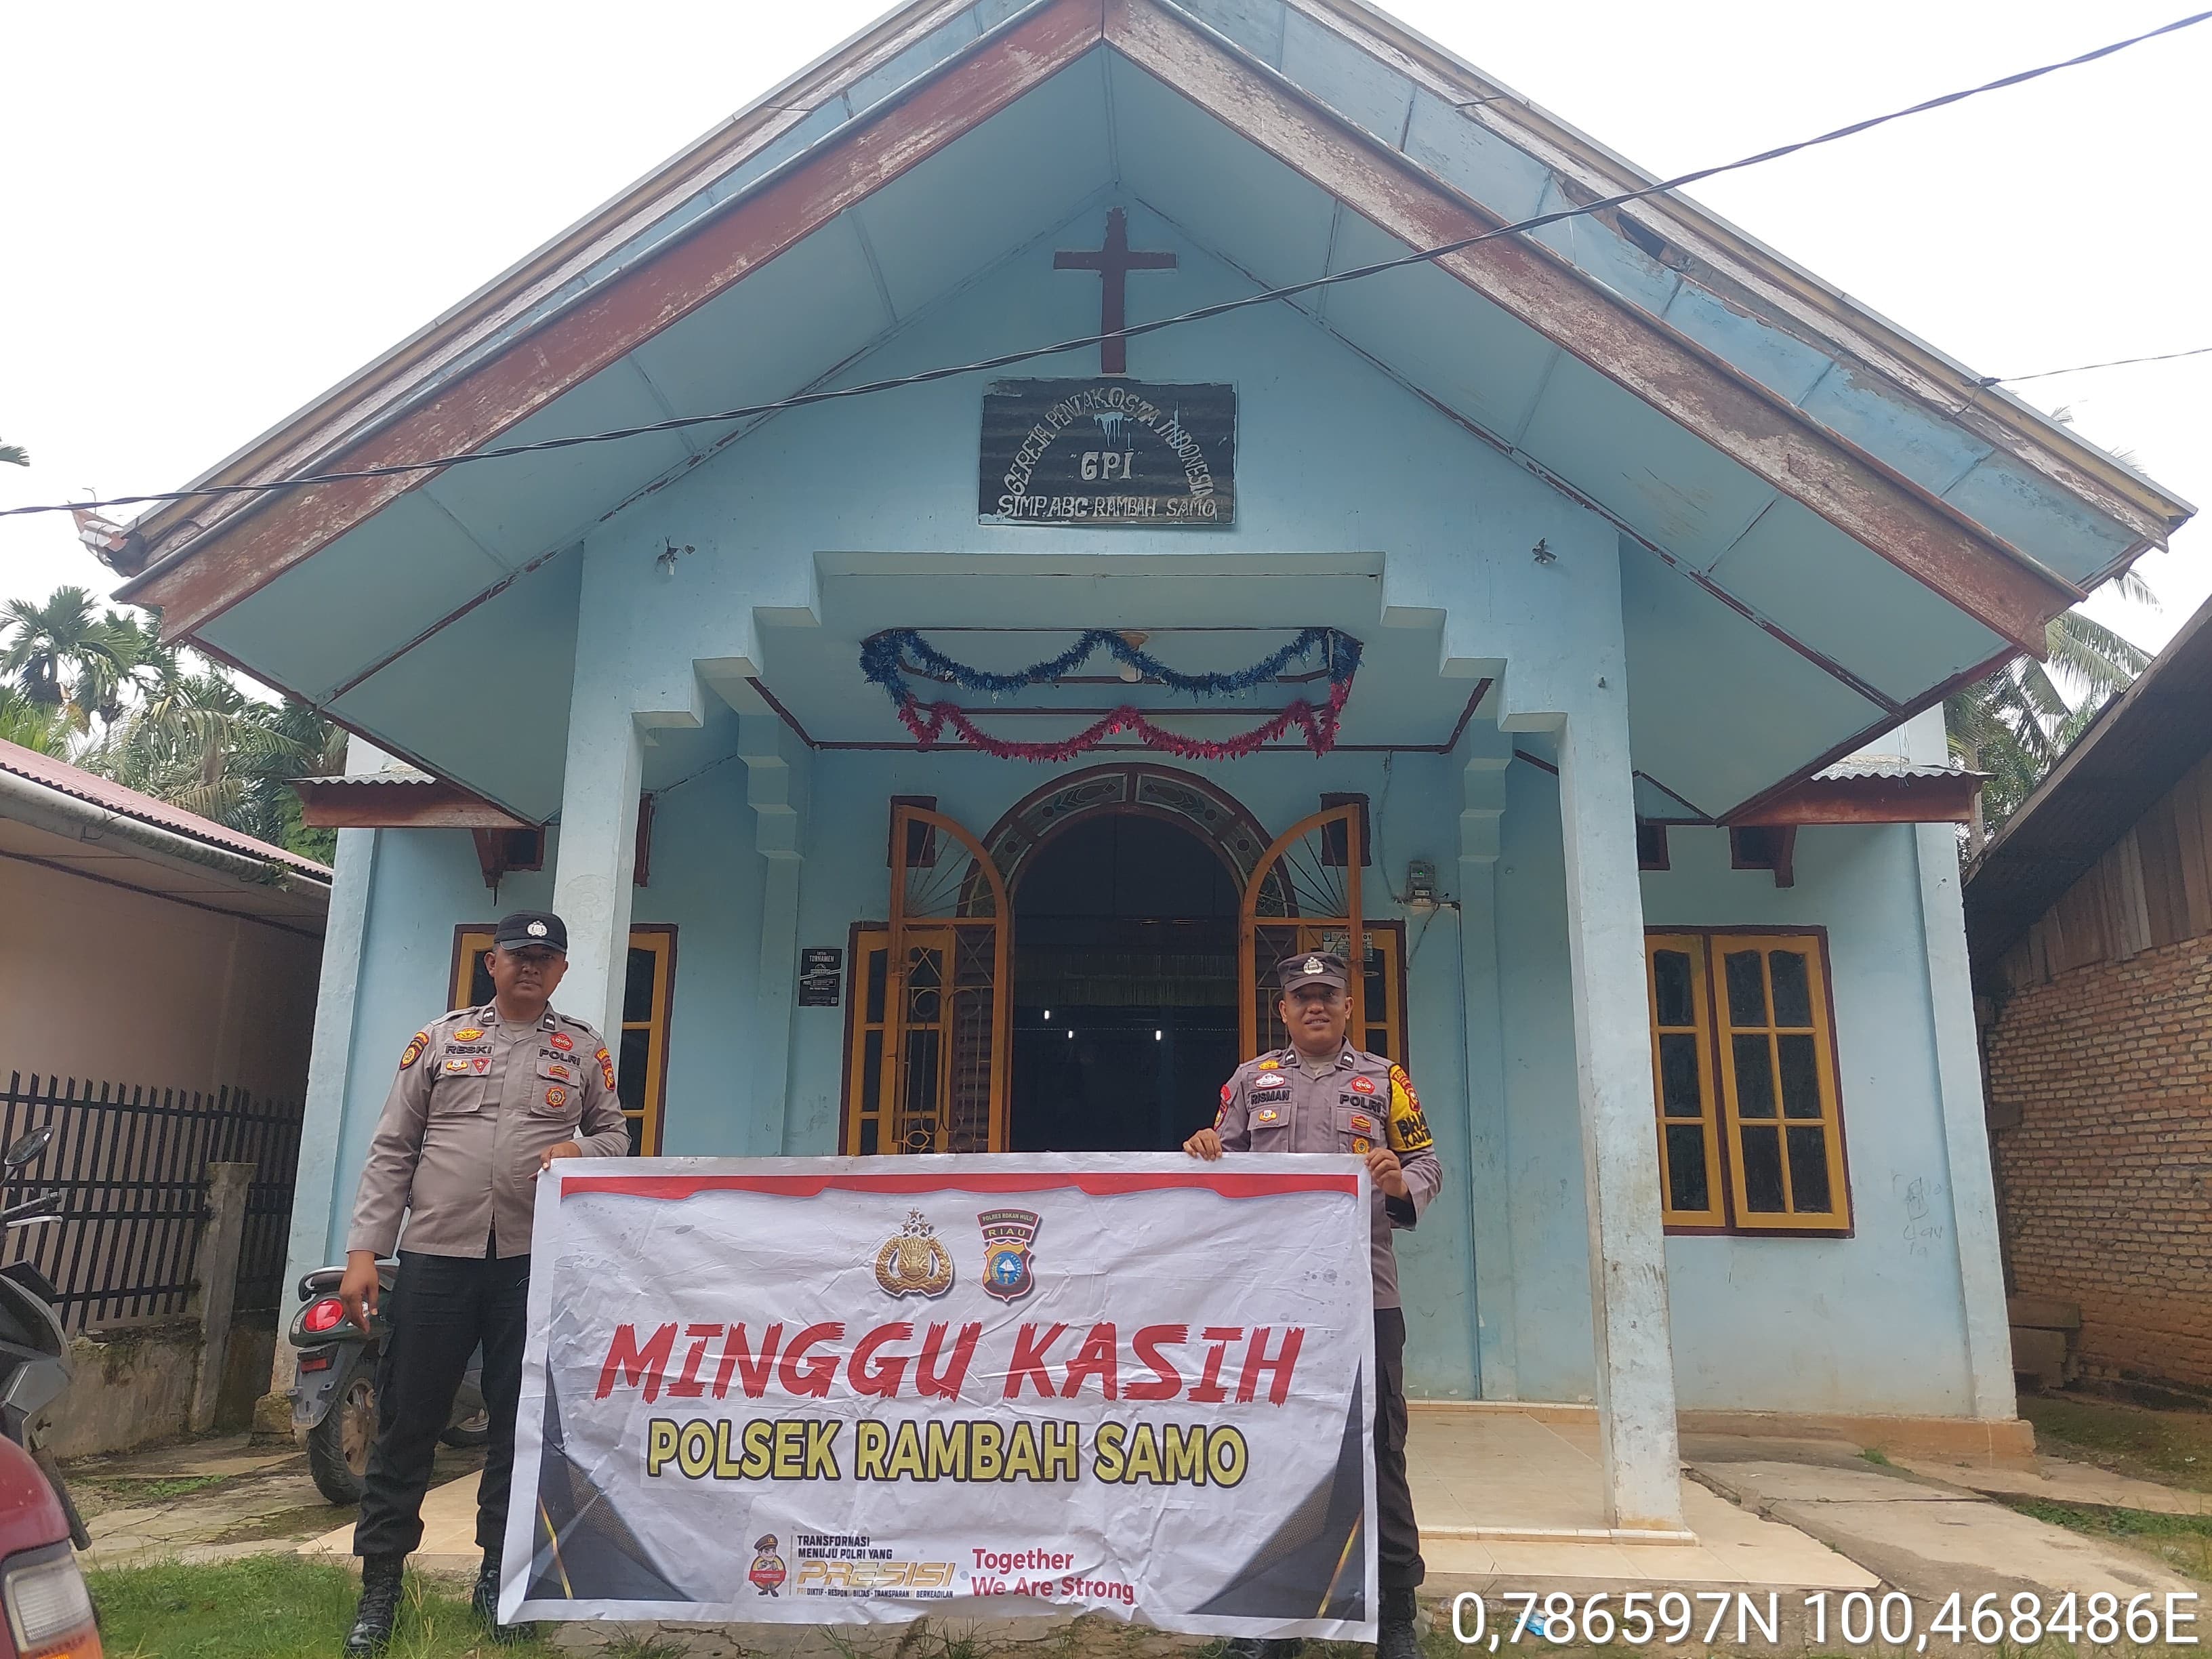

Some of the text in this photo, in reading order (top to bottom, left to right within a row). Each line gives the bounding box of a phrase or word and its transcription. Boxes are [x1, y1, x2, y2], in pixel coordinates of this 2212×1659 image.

[1004, 423, 1056, 495] GEREJA
[1044, 387, 1161, 430] PENTAKOSTA
[1166, 498, 1216, 518] SAMO
[445, 1045, 493, 1054] RESKI
[539, 1048, 581, 1066] POLRI
[1250, 1090, 1290, 1105] RISMAN
[1339, 1094, 1381, 1113] POLRI
[988, 1228, 1026, 1237] RIAU
[594, 1320, 1305, 1408] MINGGU KASIH
[647, 1418, 1249, 1488] POLSEK RAMBAH SAMO
[797, 1535, 870, 1547] TRANSFORMASI
[798, 1548, 893, 1559] MENUJU POLRI YANG
[972, 1548, 1074, 1574] Together
[796, 1561, 956, 1586] PRESISI
[971, 1576, 1134, 1605] We Are Strong
